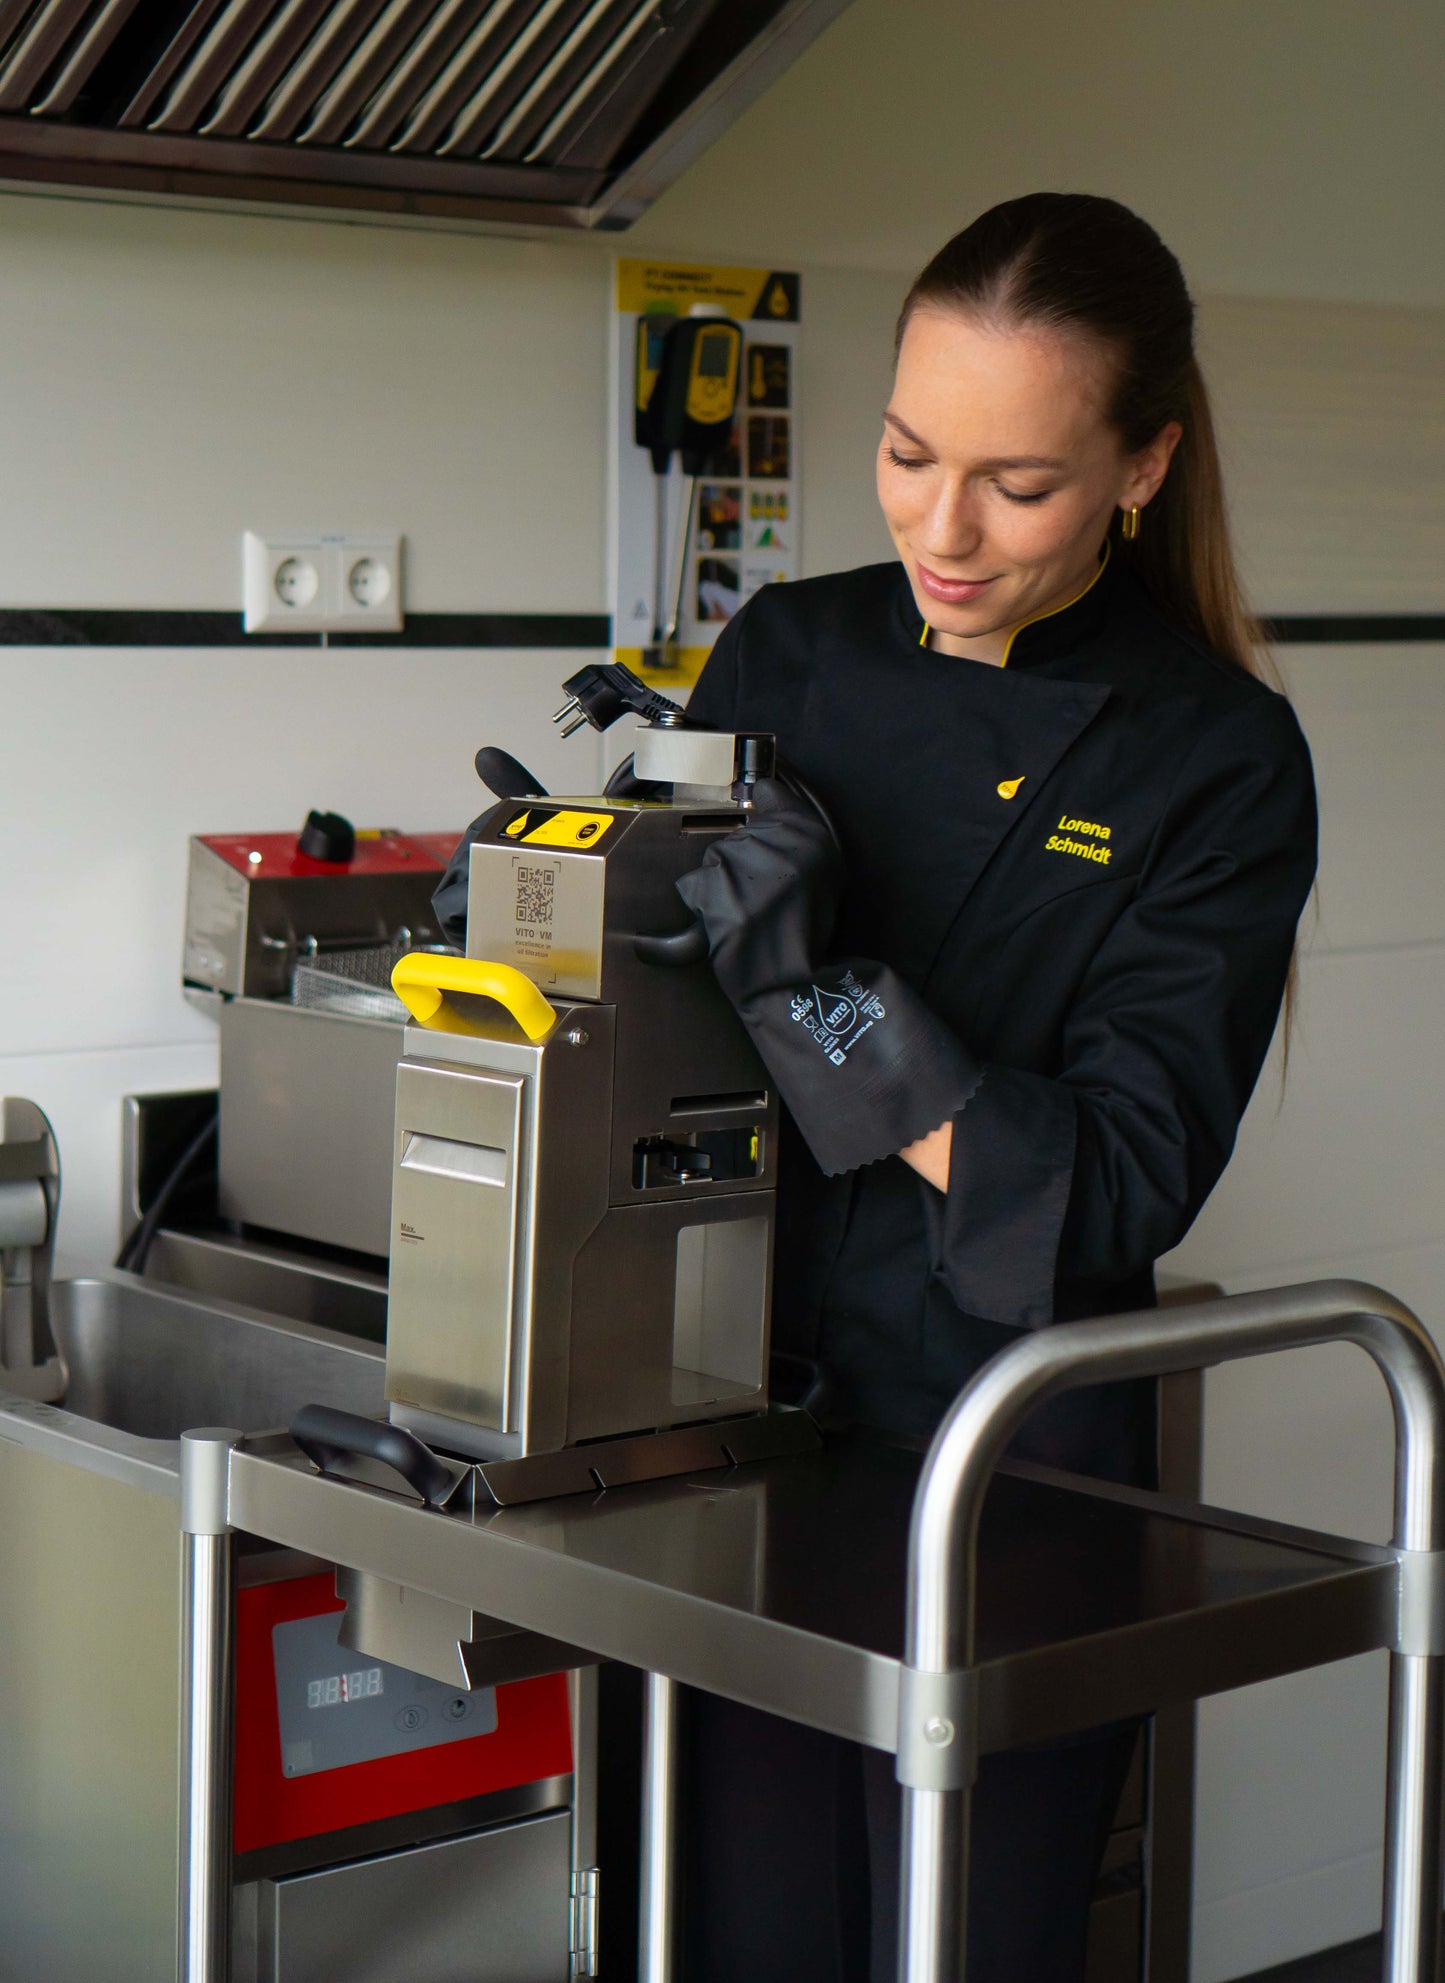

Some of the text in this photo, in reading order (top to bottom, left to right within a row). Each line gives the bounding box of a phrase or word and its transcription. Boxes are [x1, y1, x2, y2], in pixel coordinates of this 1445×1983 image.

[1058, 815, 1111, 840] Lorena
[1045, 835, 1112, 865] Schmidt
[515, 927, 552, 941] VITO VM
[791, 998, 814, 1021] 0598
[826, 1002, 848, 1024] VITO
